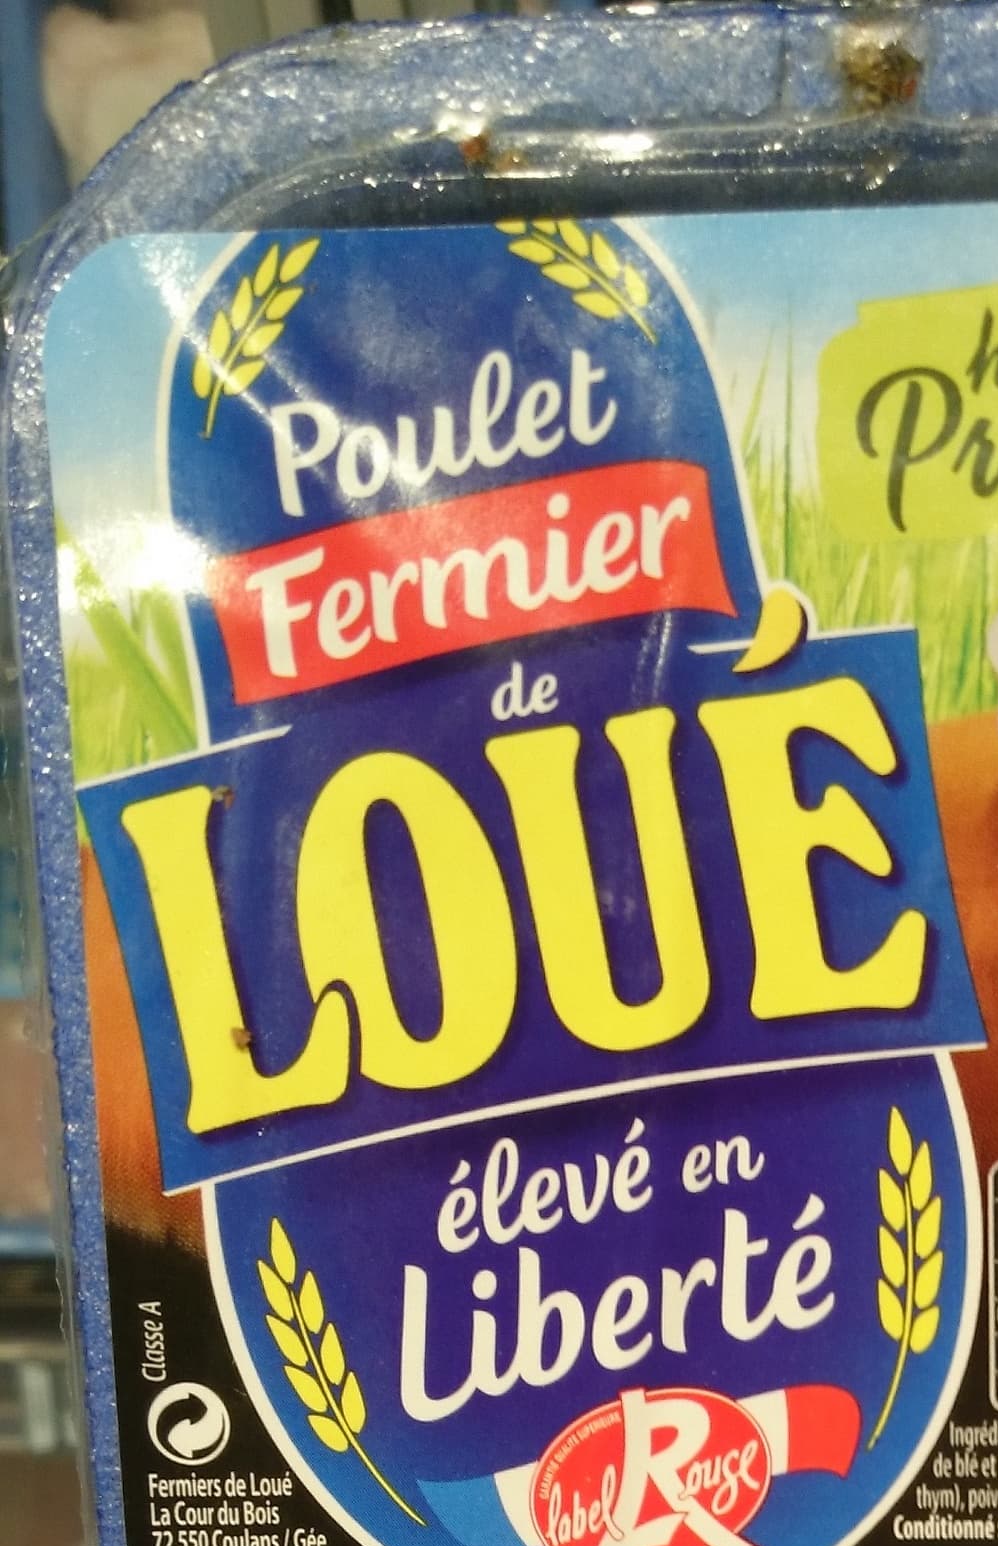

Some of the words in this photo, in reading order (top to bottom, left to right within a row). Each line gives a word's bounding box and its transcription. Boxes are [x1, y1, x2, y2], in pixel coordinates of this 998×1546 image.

[272, 349, 618, 518] Poulet
[245, 492, 691, 678] Fermier
[490, 661, 559, 721] de
[121, 590, 929, 1135] LOUÉ
[437, 1116, 653, 1254] élevé
[682, 1134, 765, 1194] en
[142, 1319, 166, 1382] Classe
[148, 1473, 221, 1498] Fermiers
[225, 1472, 247, 1496] de
[250, 1471, 293, 1496] Loué
[150, 1502, 172, 1526] La
[174, 1501, 214, 1525] Cour
[218, 1501, 240, 1525] du
[244, 1502, 279, 1525] Bois
[893, 1514, 994, 1540] Conditionné
